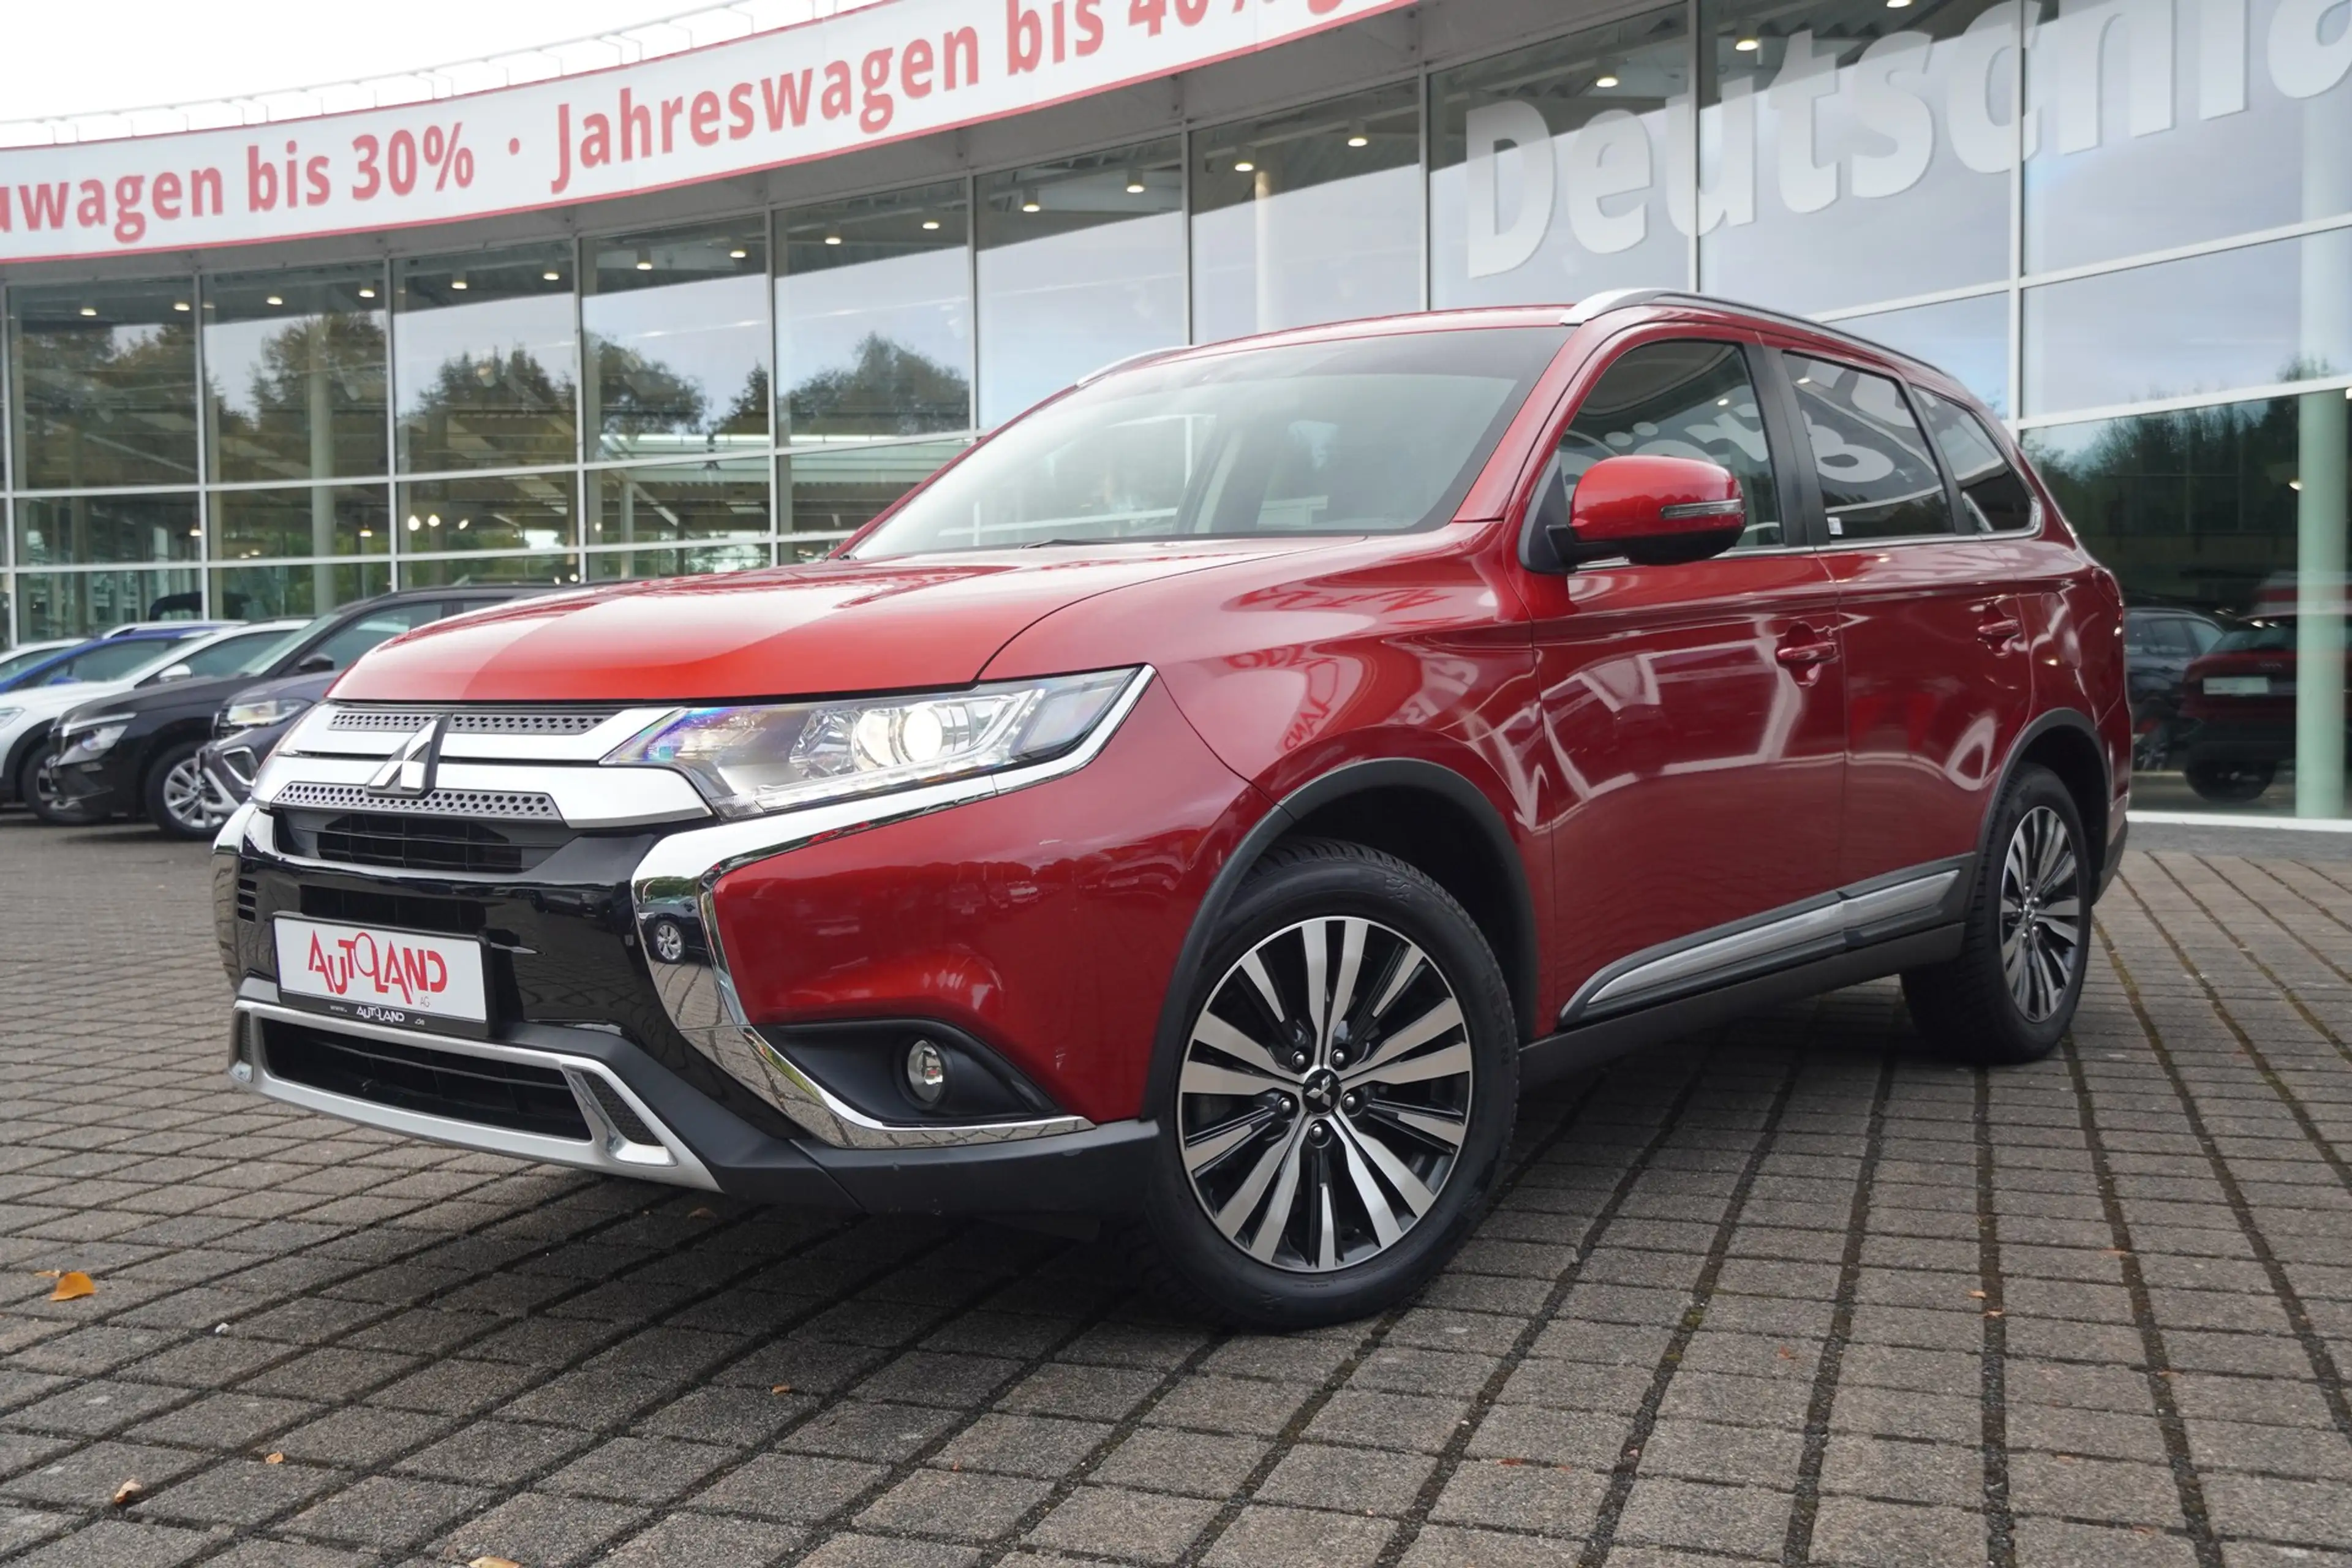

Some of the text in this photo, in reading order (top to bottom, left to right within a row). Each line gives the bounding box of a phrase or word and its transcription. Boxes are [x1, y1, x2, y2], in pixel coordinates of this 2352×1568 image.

[247, 141, 331, 213] bis
[352, 122, 475, 200] 30%
[551, 26, 980, 194] Jahreswagen
[1007, 0, 1105, 75] bis
[308, 929, 448, 1005] AUTOLAND
[356, 1006, 405, 1023] AUTOLAND
